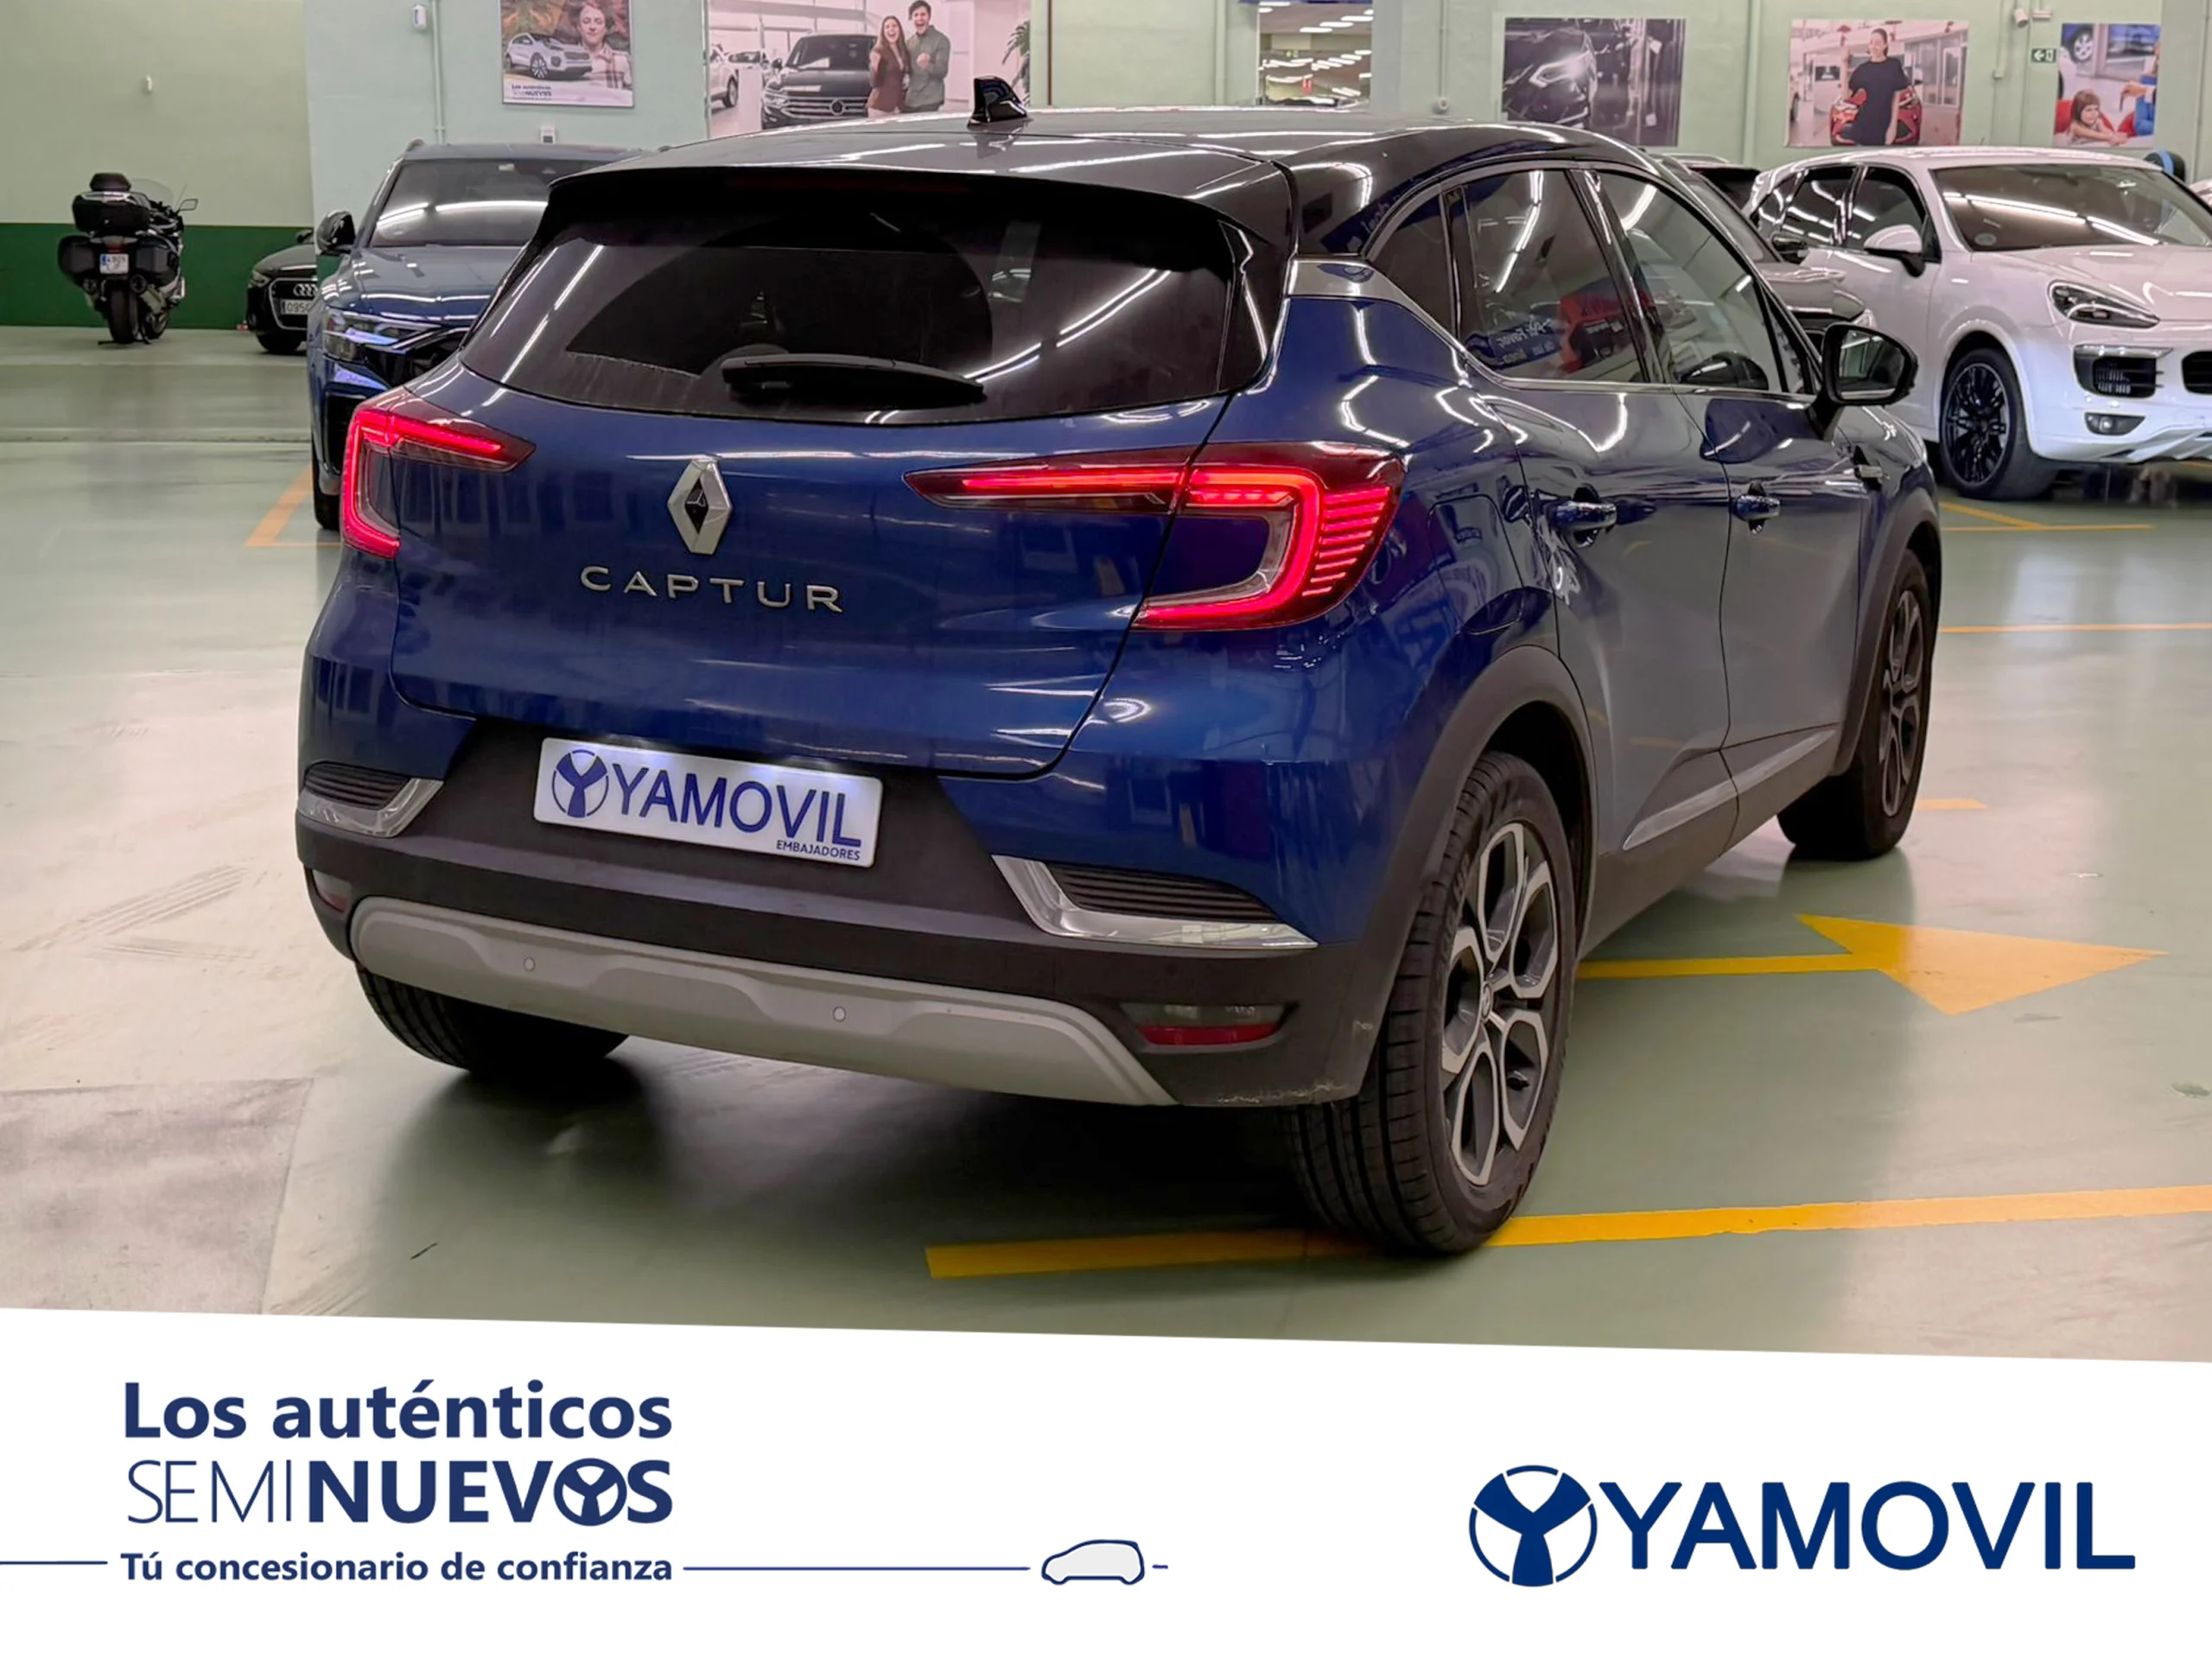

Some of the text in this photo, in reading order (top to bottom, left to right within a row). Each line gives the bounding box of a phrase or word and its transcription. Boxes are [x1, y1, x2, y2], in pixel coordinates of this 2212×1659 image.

[580, 566, 843, 613] CAPTUR
[612, 763, 861, 847] YAMOVIL
[776, 839, 861, 861] EMBAJADORES
